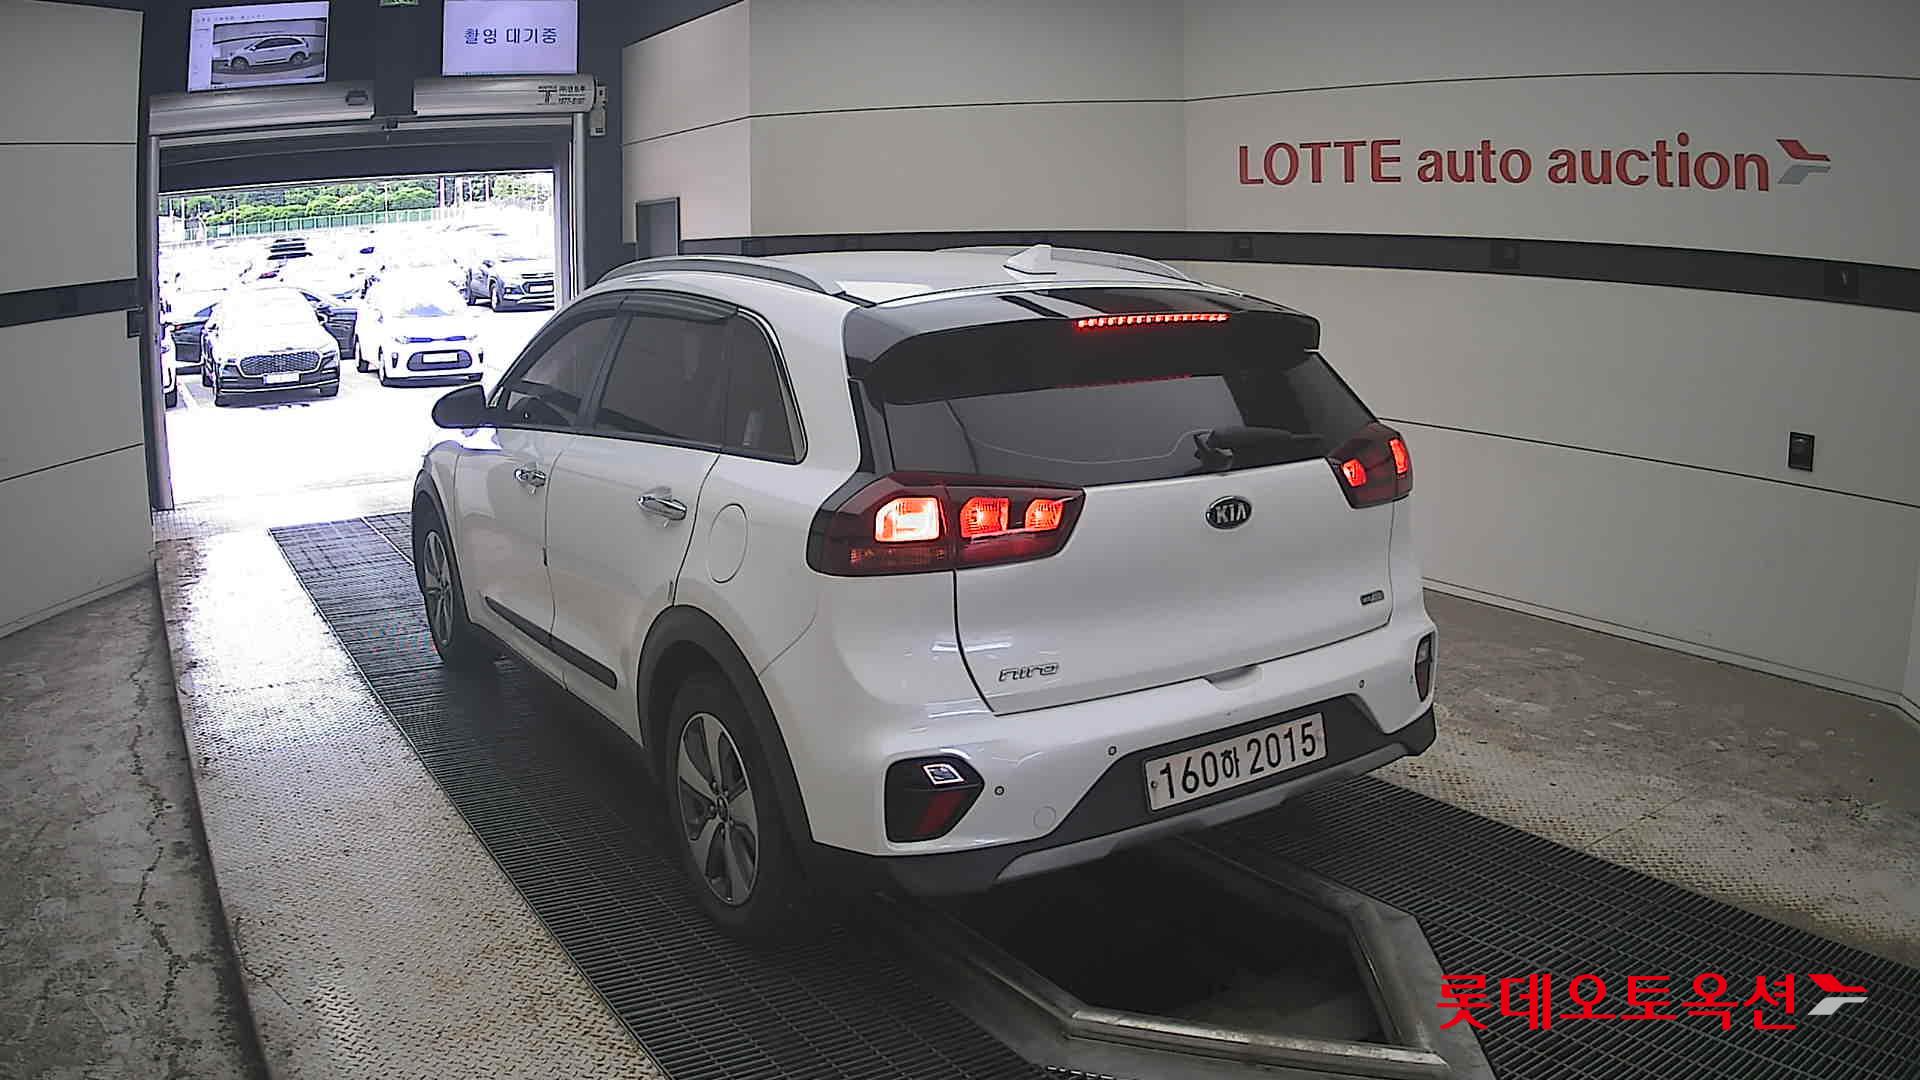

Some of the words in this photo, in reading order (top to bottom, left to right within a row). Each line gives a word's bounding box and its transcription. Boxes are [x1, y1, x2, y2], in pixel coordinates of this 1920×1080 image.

[506, 27, 558, 45] 대기중
[1238, 139, 1401, 186] LOTTE
[1417, 139, 1533, 185] auto
[1547, 132, 1770, 191] auction
[1215, 503, 1247, 524] KIA
[1159, 746, 1240, 800] 160하
[1246, 720, 1316, 775] 2015
